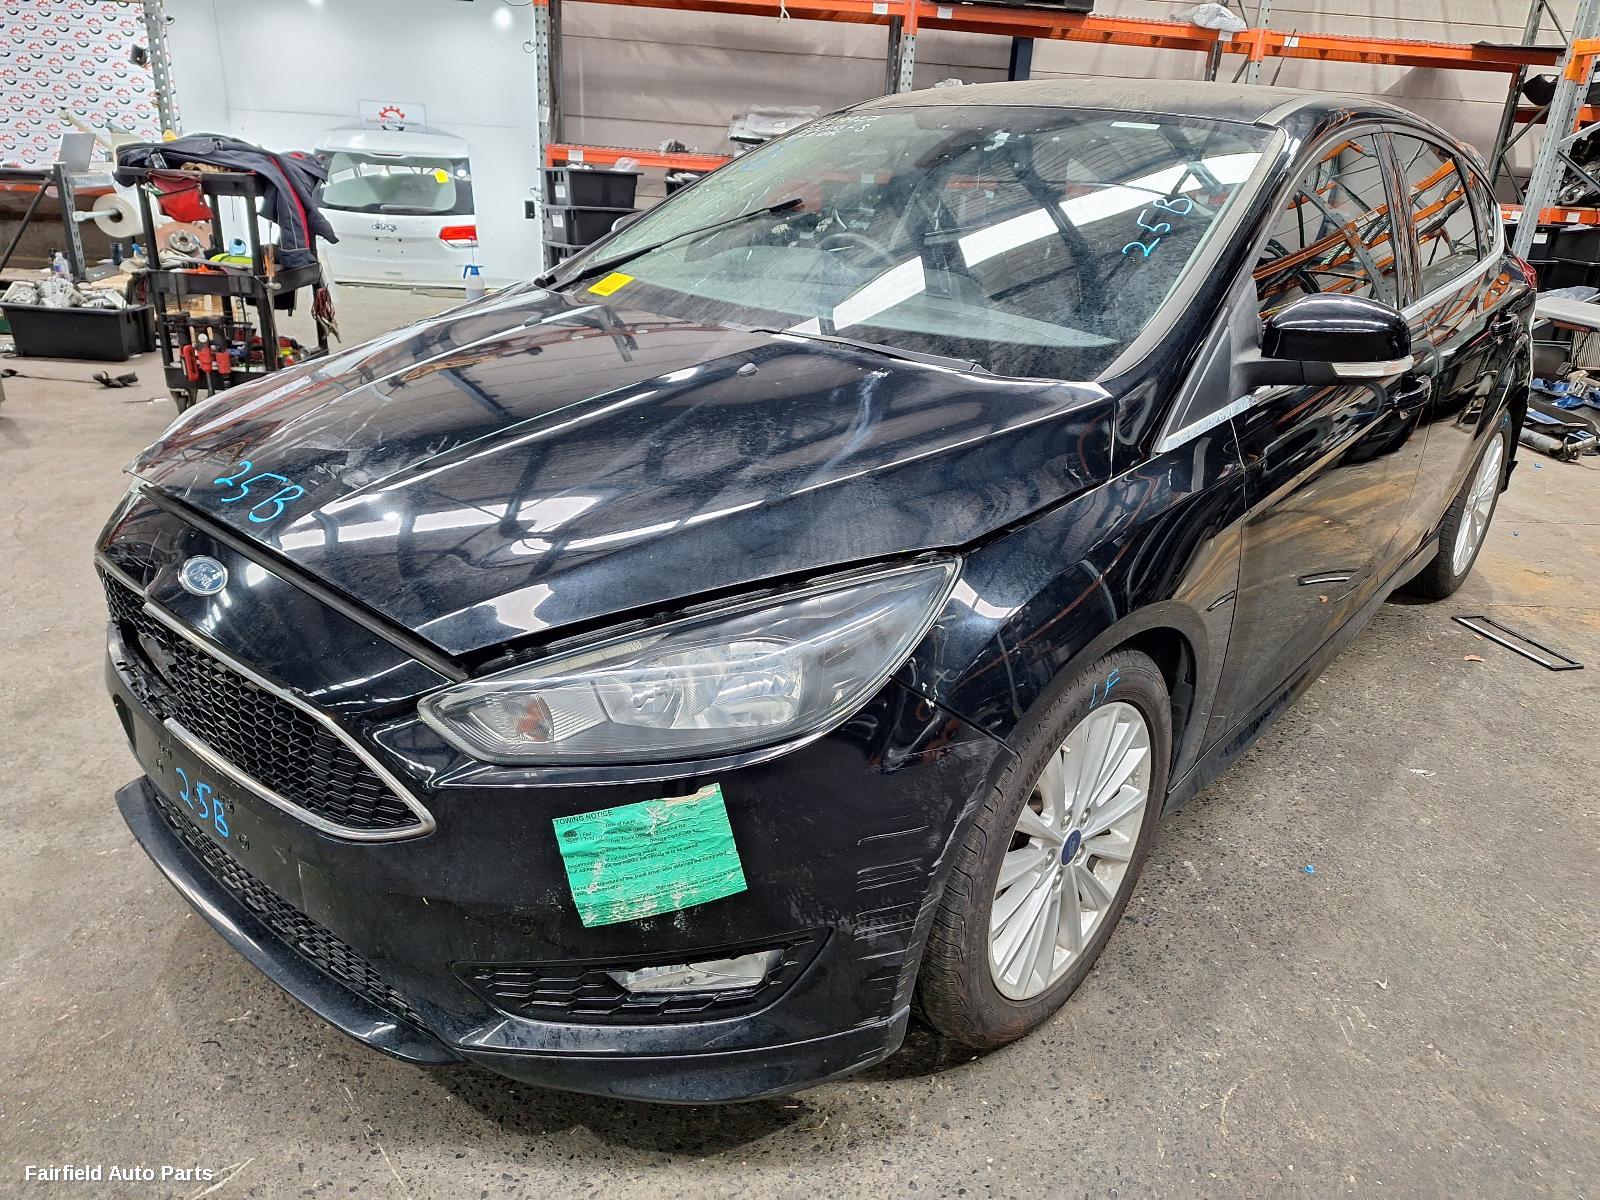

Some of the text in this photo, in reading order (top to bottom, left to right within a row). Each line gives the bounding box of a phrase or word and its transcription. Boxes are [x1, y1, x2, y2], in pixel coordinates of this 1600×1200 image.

[1121, 197, 1194, 258] 25B
[213, 460, 305, 523] 25B
[175, 766, 229, 839] 25B
[555, 810, 614, 826] TOWING NOTICE
